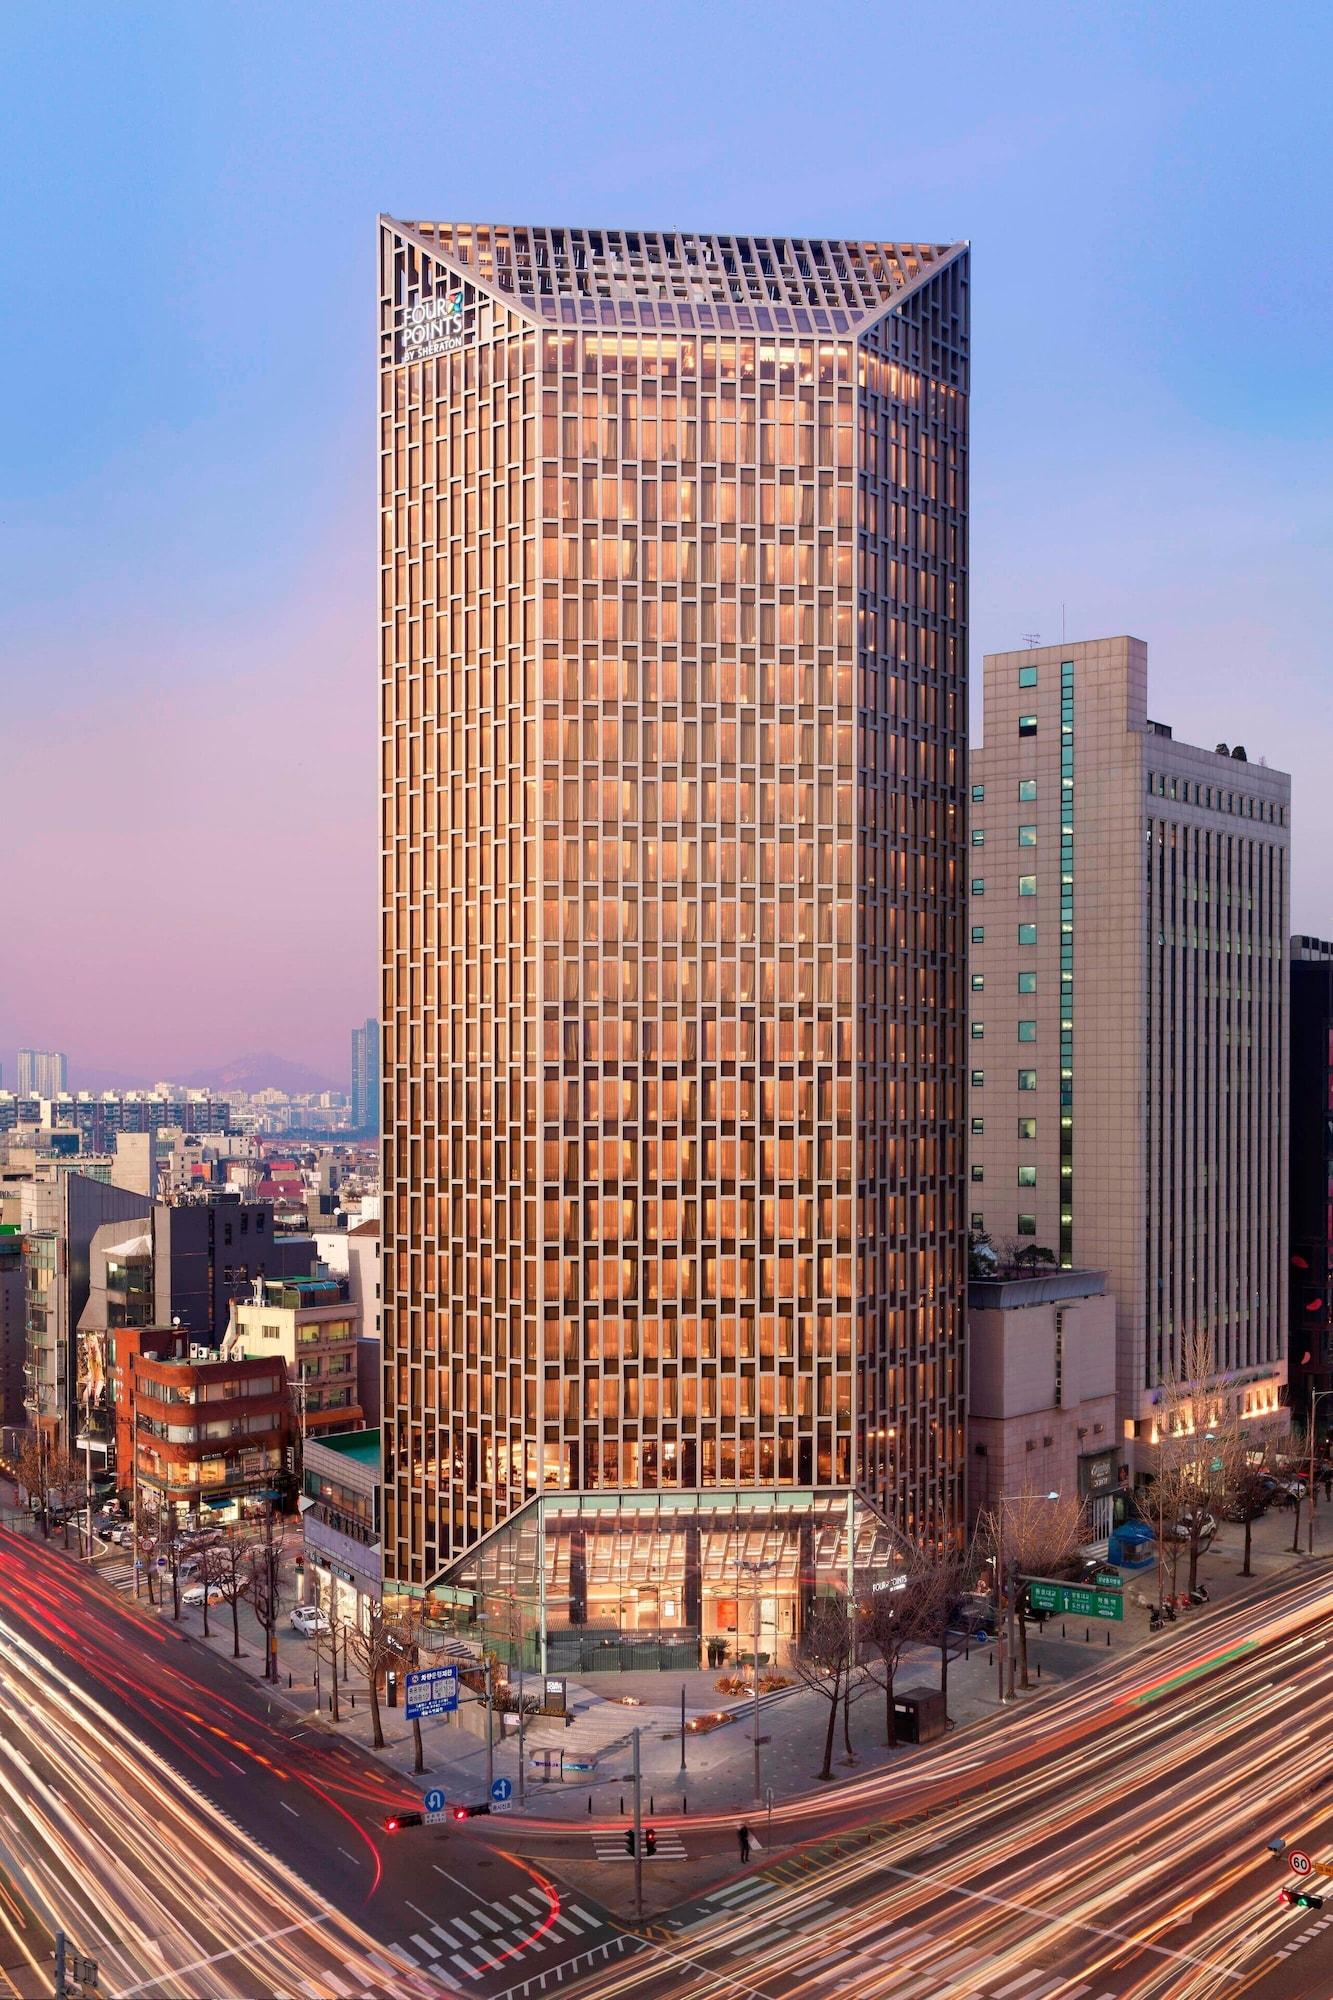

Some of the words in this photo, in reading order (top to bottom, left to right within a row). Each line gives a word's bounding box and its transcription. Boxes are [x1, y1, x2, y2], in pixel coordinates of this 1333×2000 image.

[402, 298, 446, 327] FOUR
[402, 314, 463, 347] POINTS
[404, 350, 415, 362] BY
[417, 337, 462, 359] SHERATON
[1293, 1856, 1307, 1870] 60
